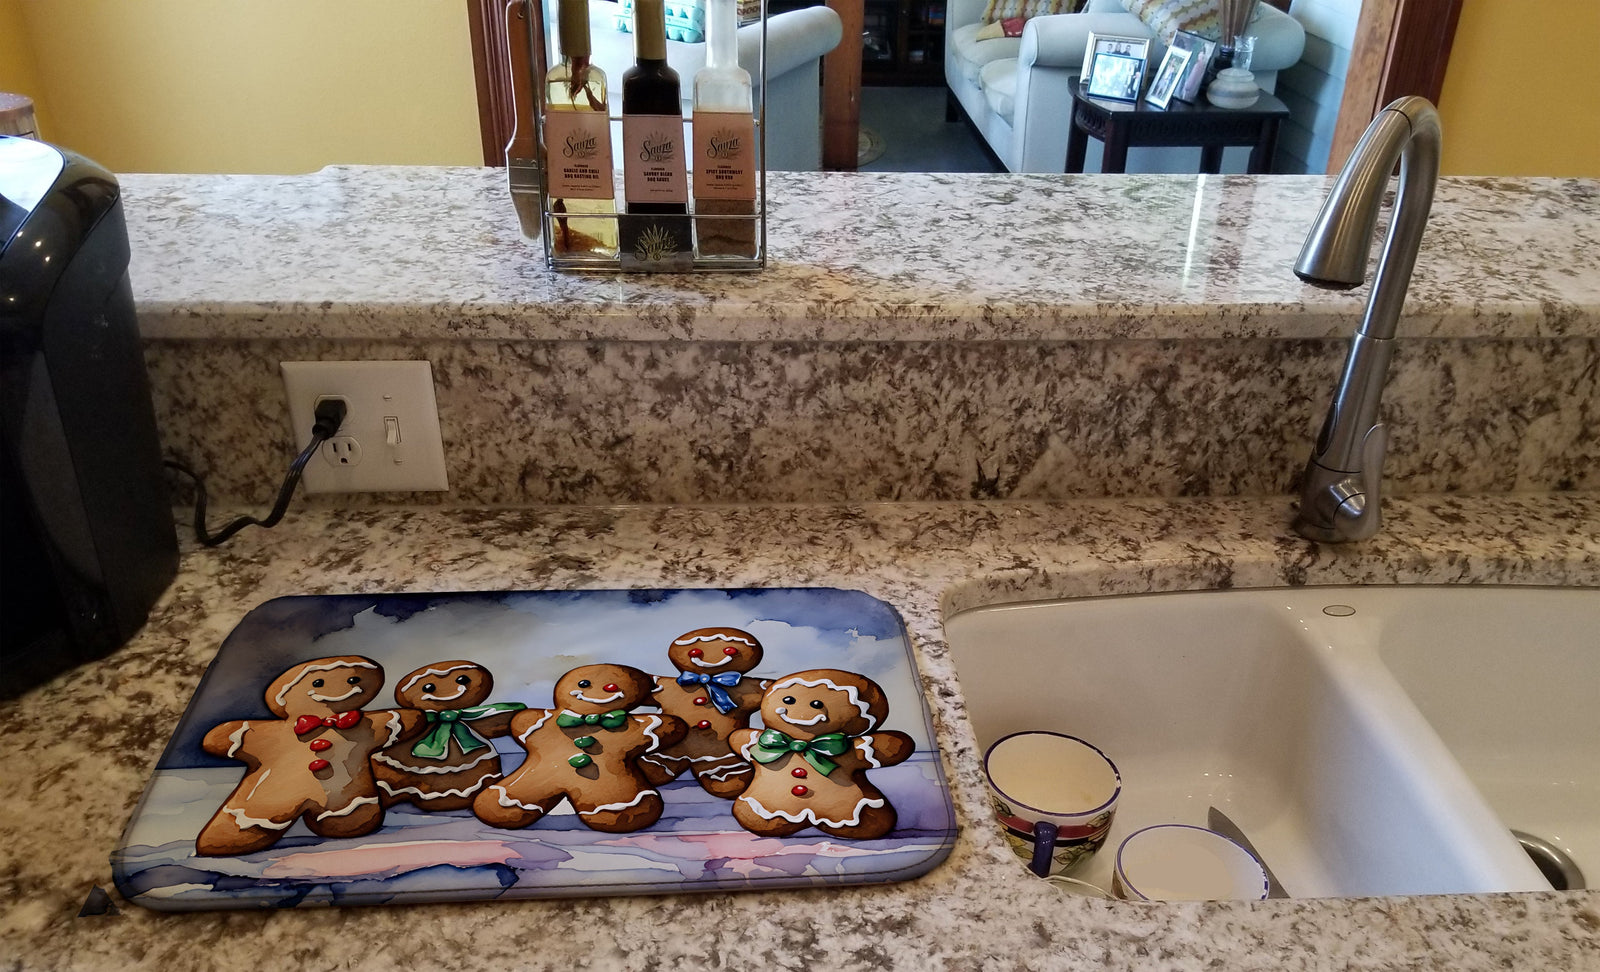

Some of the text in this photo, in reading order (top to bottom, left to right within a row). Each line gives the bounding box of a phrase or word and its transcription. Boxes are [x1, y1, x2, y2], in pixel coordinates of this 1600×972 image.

[563, 136, 597, 158] Sauza
[640, 140, 673, 161] Sauza
[707, 137, 740, 159] Sauza
